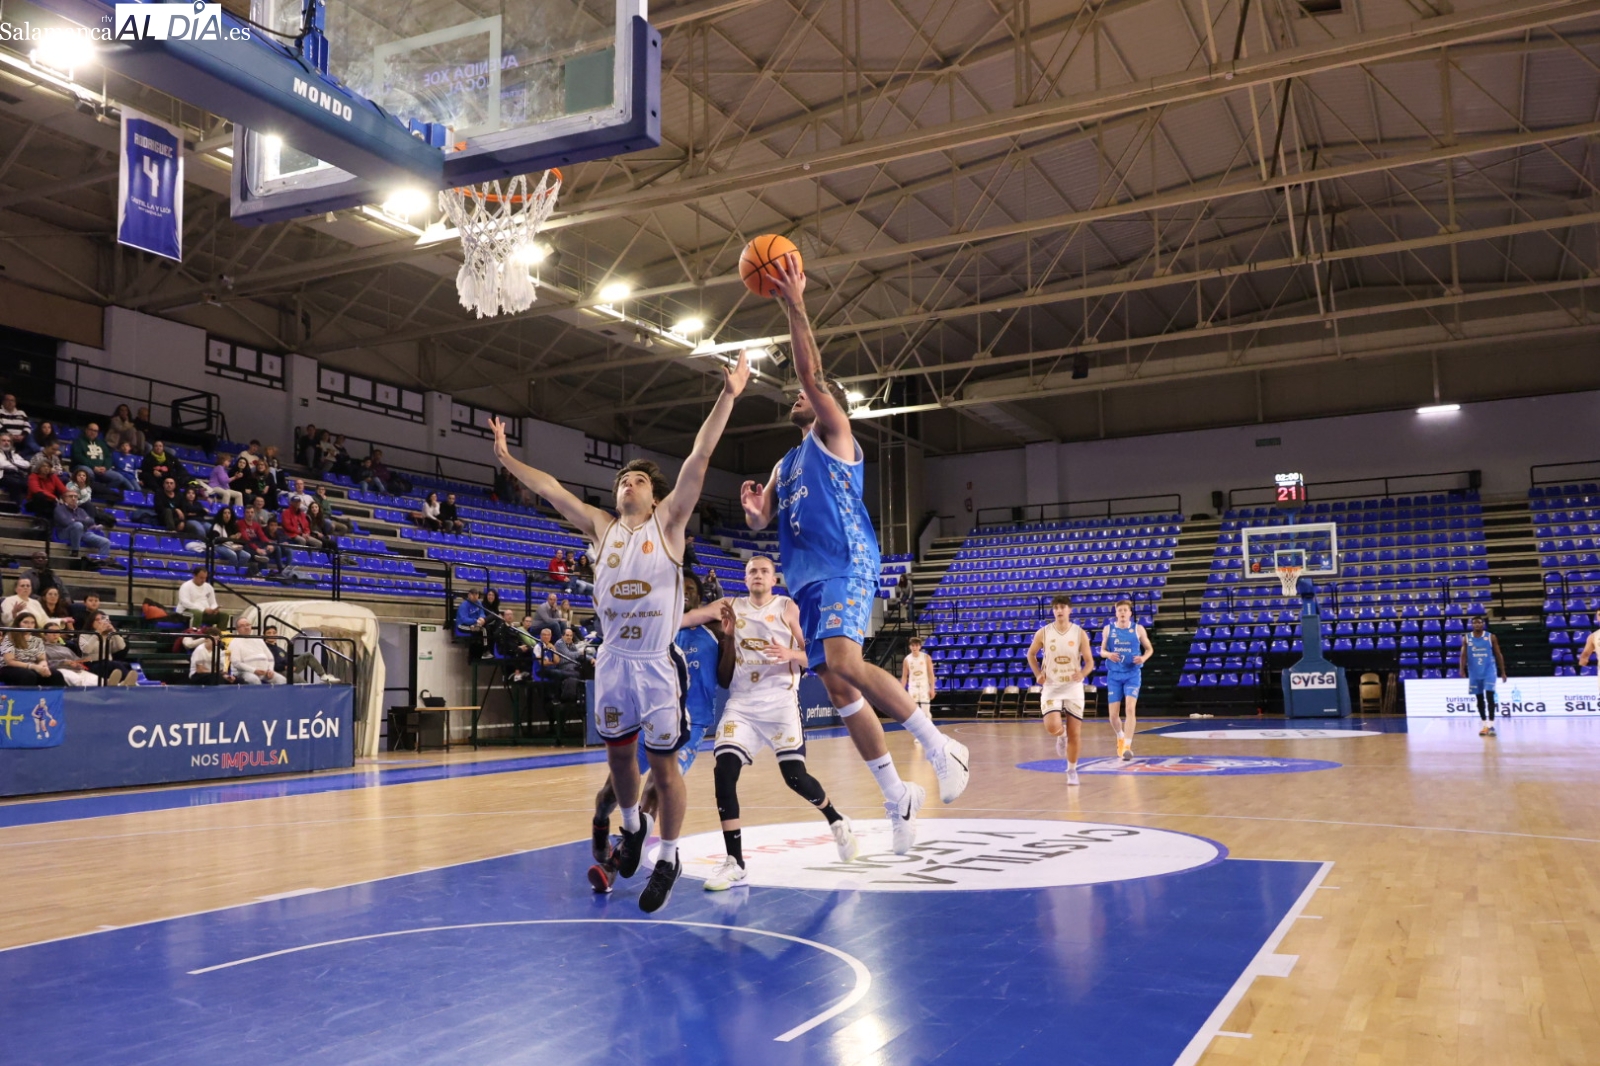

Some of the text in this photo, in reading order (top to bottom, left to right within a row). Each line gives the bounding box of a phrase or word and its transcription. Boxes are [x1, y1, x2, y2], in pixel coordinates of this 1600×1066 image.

[292, 76, 353, 122] MONDO
[142, 154, 160, 198] 4
[1277, 486, 1297, 501] 21
[613, 582, 648, 597] ABRIL
[619, 625, 643, 640] 29
[751, 671, 760, 683] 8
[127, 710, 340, 749] CASTILLA Y LEÓN
[191, 748, 289, 772] NOS IMPULSA
